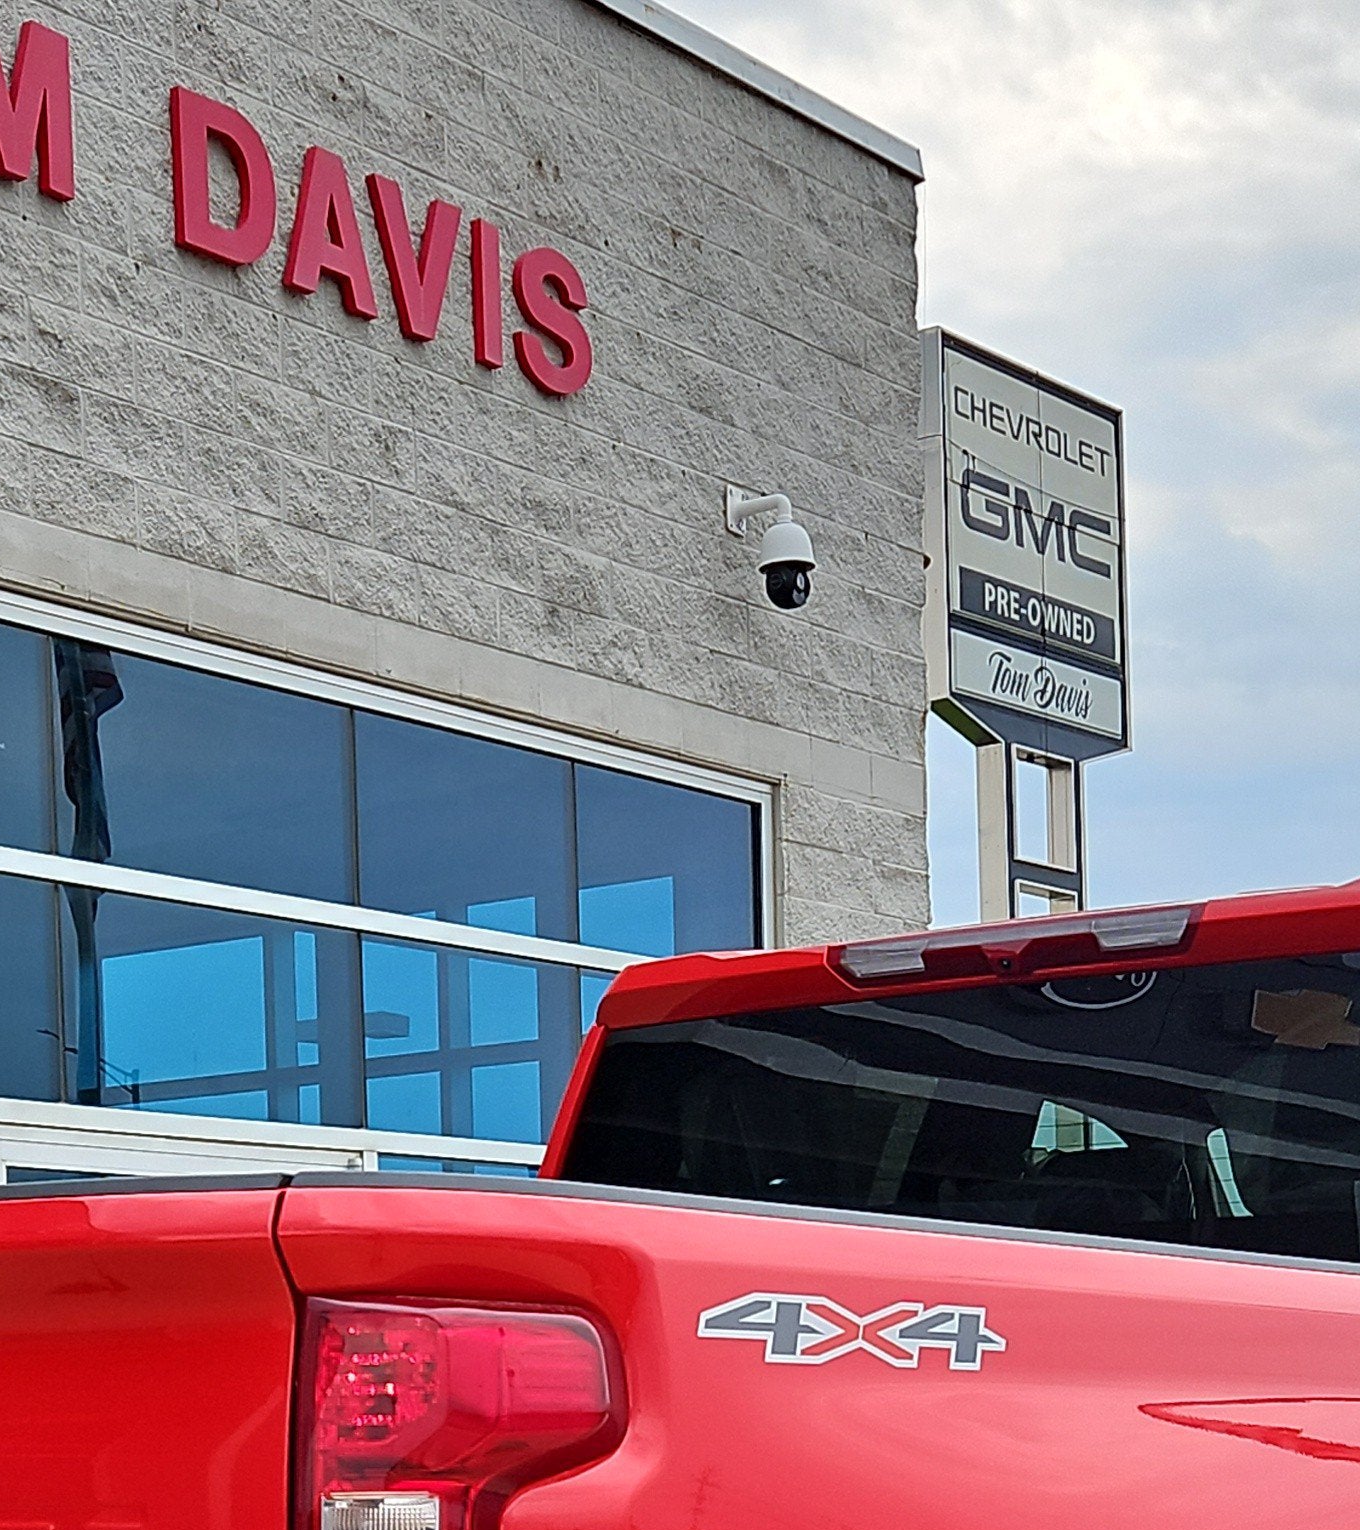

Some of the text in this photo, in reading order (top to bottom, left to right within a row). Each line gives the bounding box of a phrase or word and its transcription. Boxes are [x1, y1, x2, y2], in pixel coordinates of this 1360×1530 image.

[170, 86, 592, 396] DAVIS
[954, 385, 1111, 477] CHEVROLET
[961, 468, 1111, 579] GMC
[984, 582, 1096, 645] PRE-OWNED
[989, 651, 1093, 719] Tom Davis
